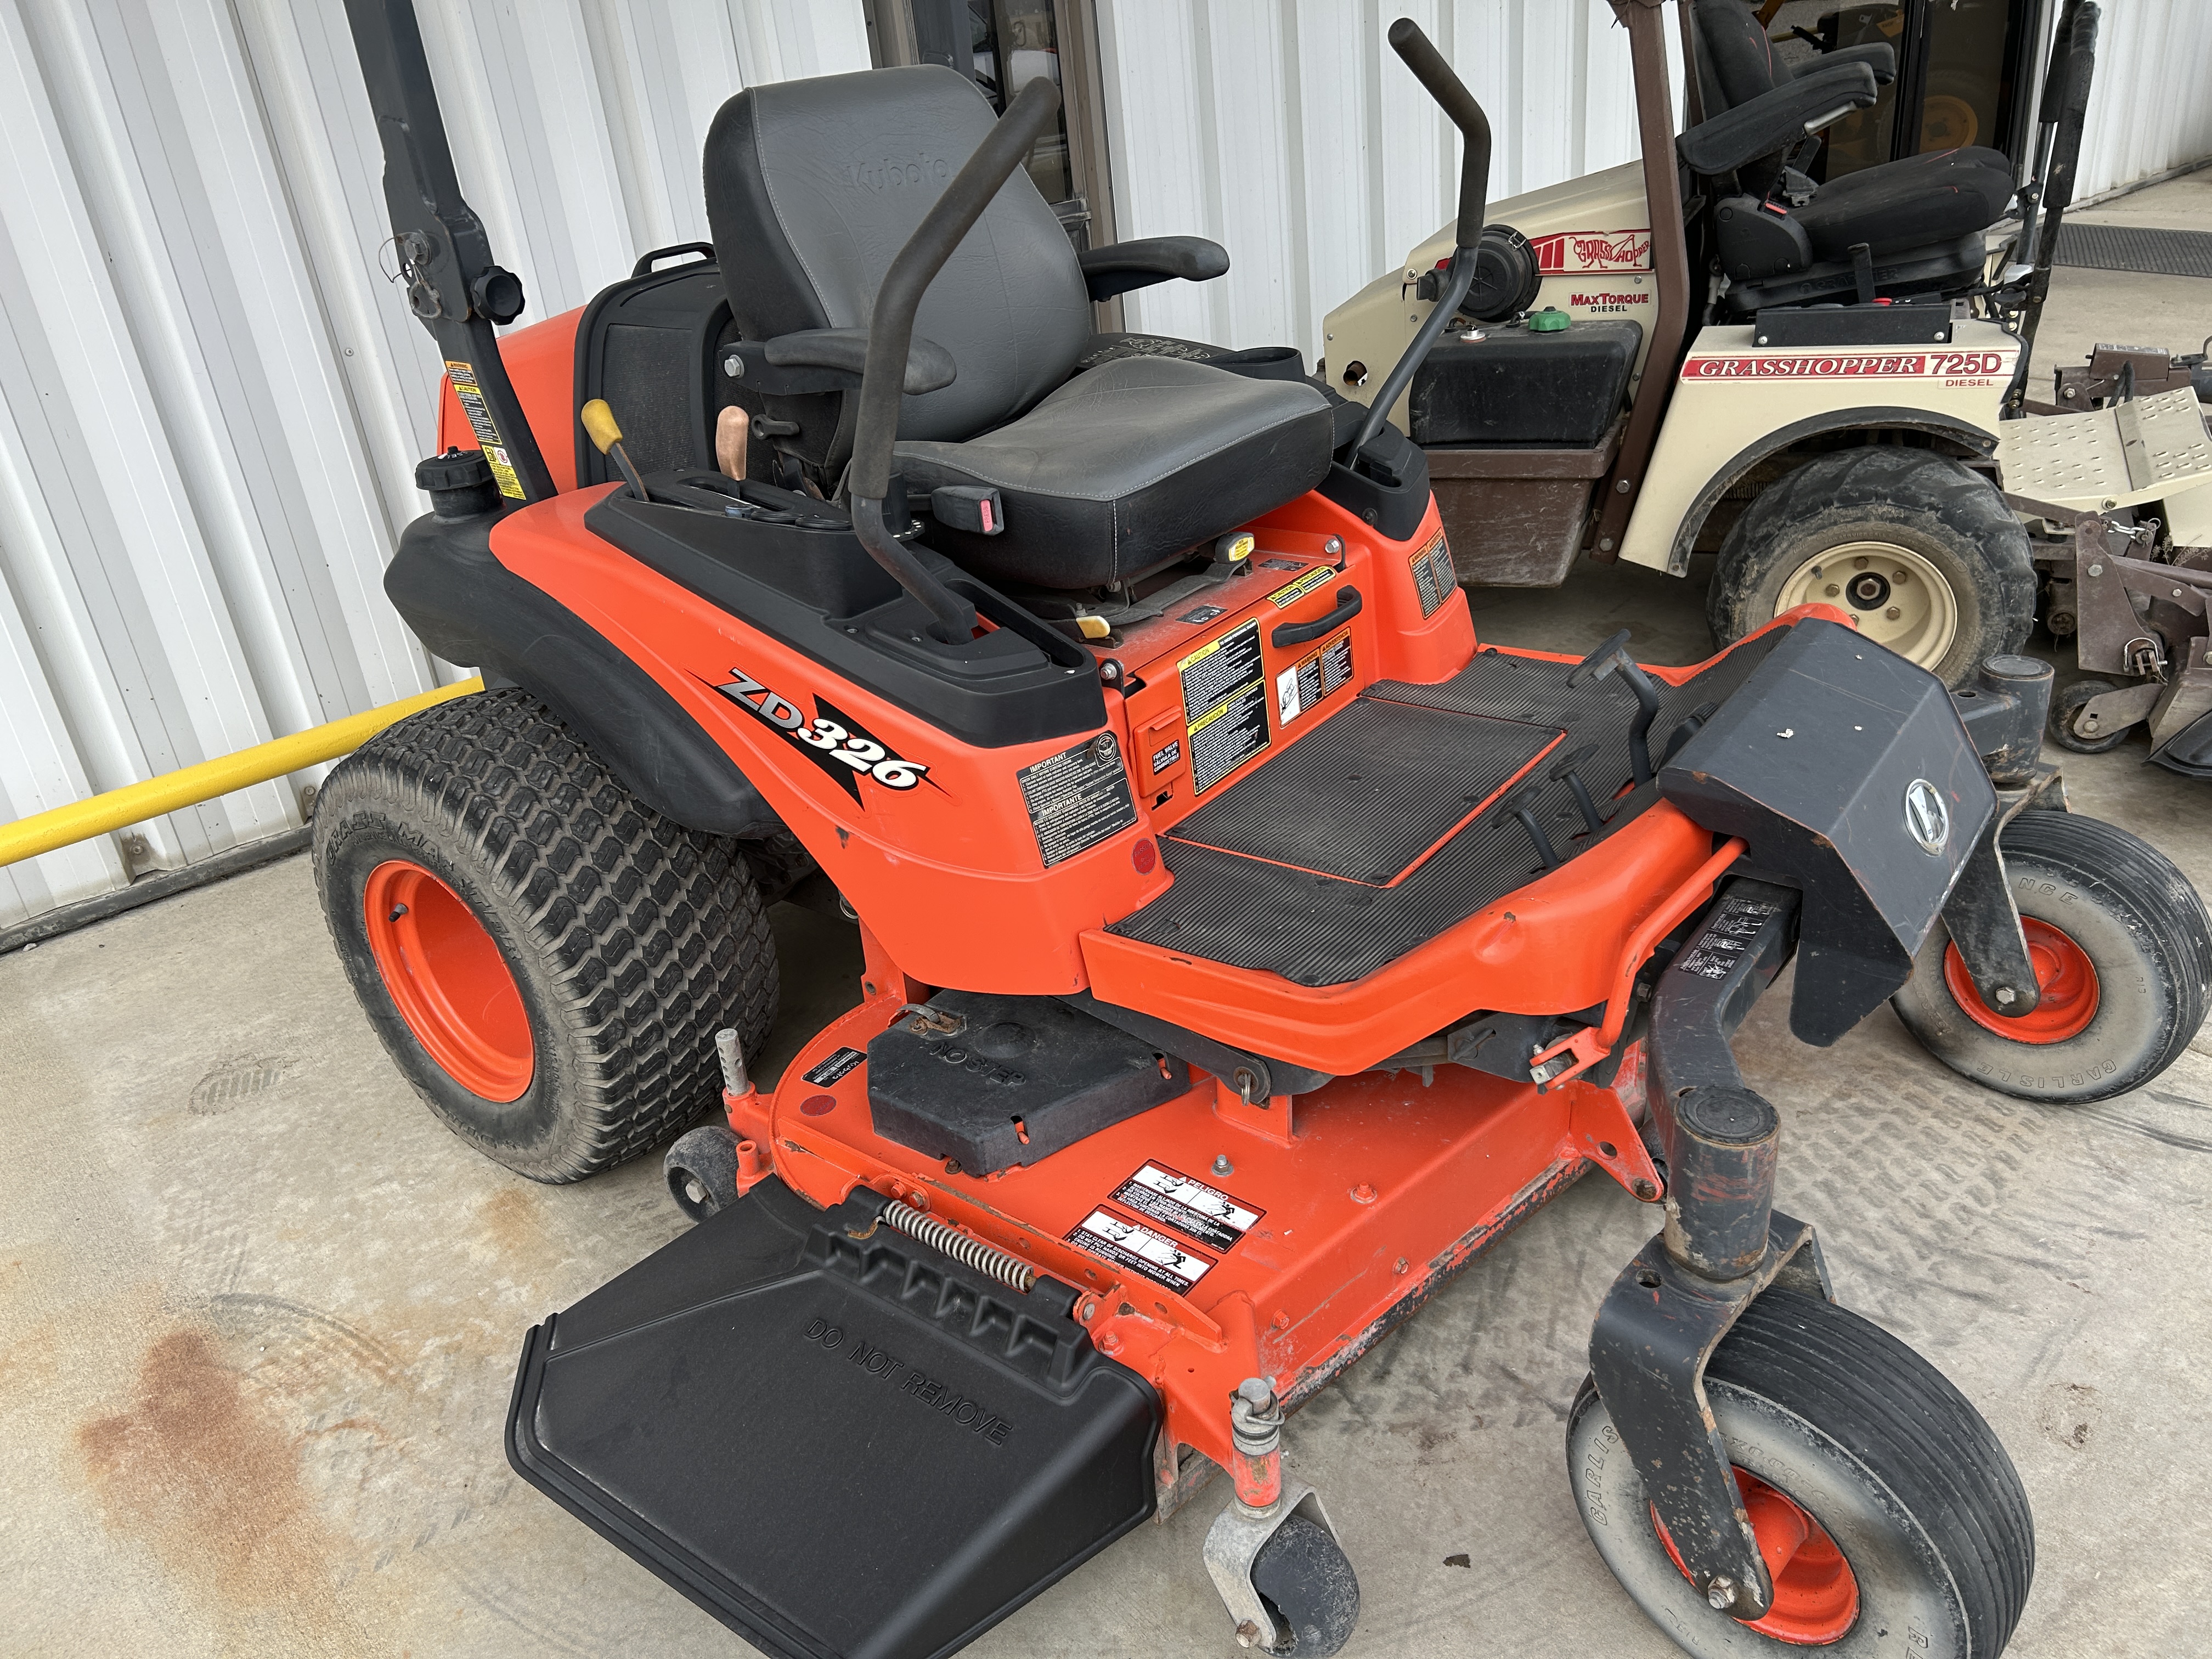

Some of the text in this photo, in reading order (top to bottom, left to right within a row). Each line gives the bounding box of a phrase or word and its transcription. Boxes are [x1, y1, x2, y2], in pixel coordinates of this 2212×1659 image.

[1573, 239, 1650, 263] GRASSHOPPER
[1700, 354, 2002, 377] GRASSHOPPER 725D
[1945, 379, 1994, 387] DIESEL
[1190, 647, 1209, 663] CAUTION
[718, 667, 927, 787] ZD326
[1029, 752, 1067, 773] IMPORTANT
[1153, 741, 1178, 761] FUEL VALVE
[1041, 793, 1082, 817] IMPORTANTE
[831, 1059, 859, 1080] Kubota
[1976, 1059, 2118, 1088] CARLISLE
[1186, 1179, 1230, 1201] PELIGRO
[1073, 1237, 1091, 1247] ENGINE
[1139, 1226, 1179, 1248] DANGER
[1091, 1236, 1107, 1245] CLEAR
[1111, 1246, 1139, 1261] DISCHARGE
[1137, 1259, 1159, 1271] OPENING
[1102, 1246, 1119, 1256] HANDS
[1146, 1268, 1167, 1280] MOWER
[1164, 1277, 1181, 1287] WHEN
[804, 1319, 1013, 1446] DO NOT REMOVE
[1585, 1425, 1619, 1526] CARLIS
